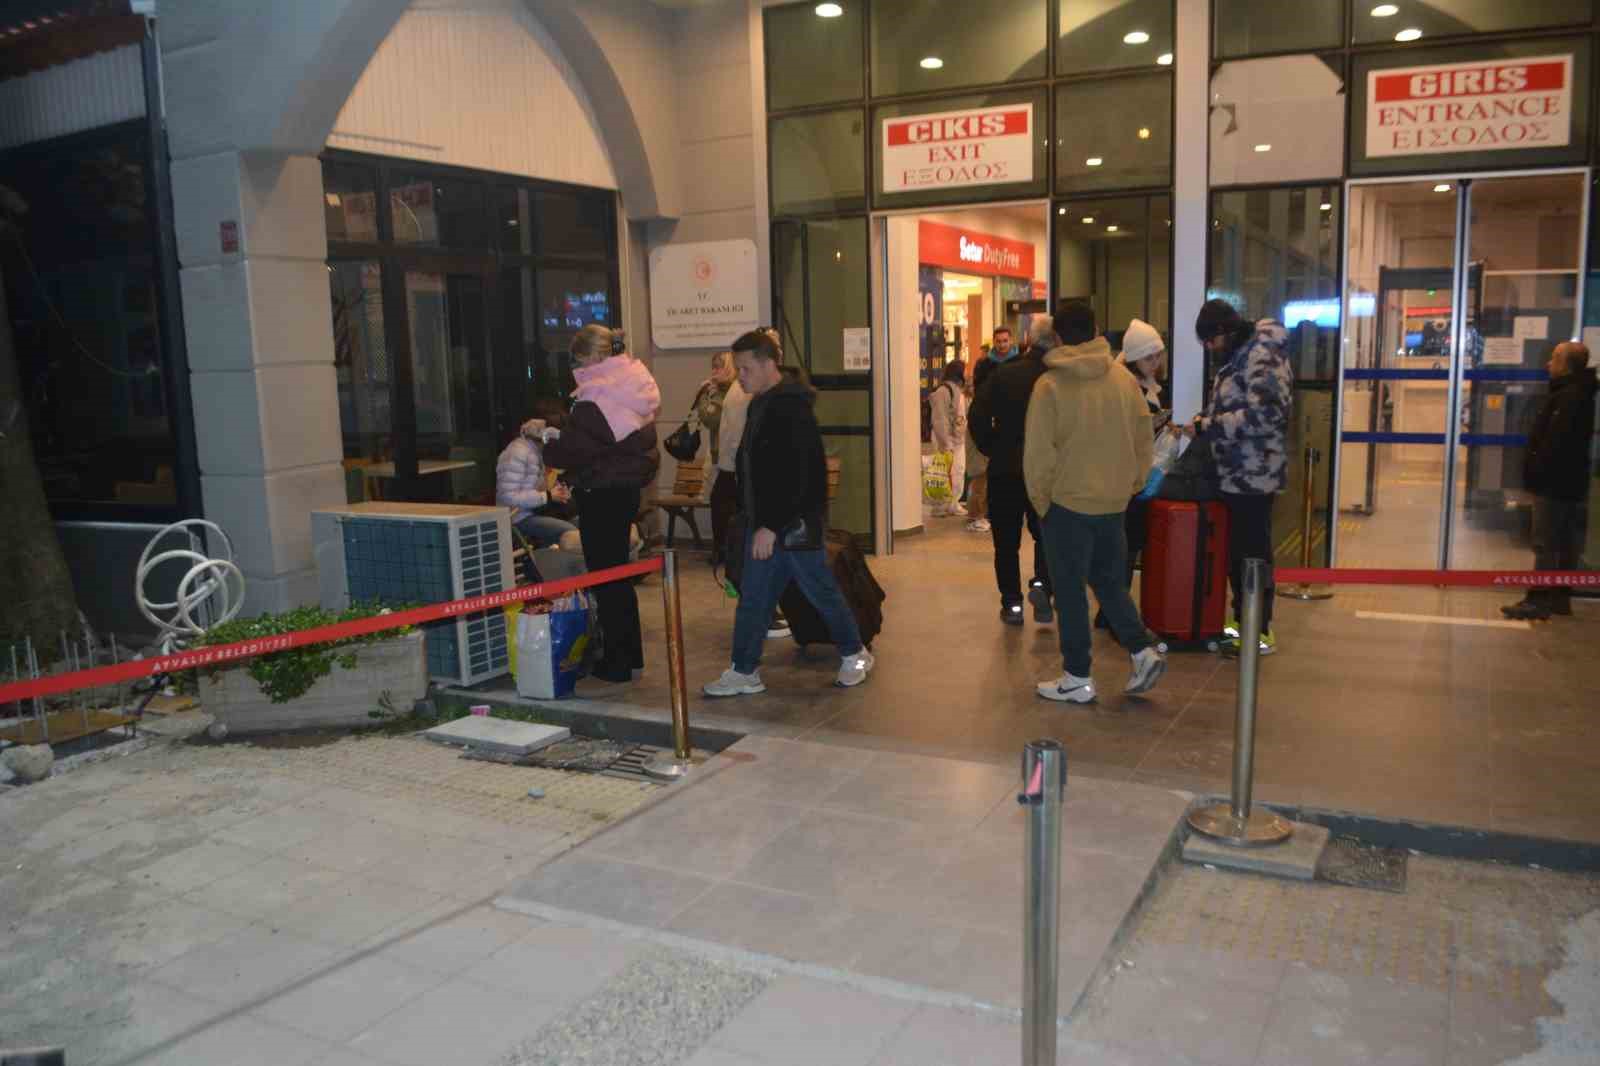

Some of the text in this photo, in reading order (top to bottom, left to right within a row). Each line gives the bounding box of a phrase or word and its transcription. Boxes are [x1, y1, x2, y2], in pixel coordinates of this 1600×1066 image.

[1378, 96, 1561, 127] ENTRANCE
[928, 142, 985, 163] EXIT
[960, 235, 983, 262] Setur
